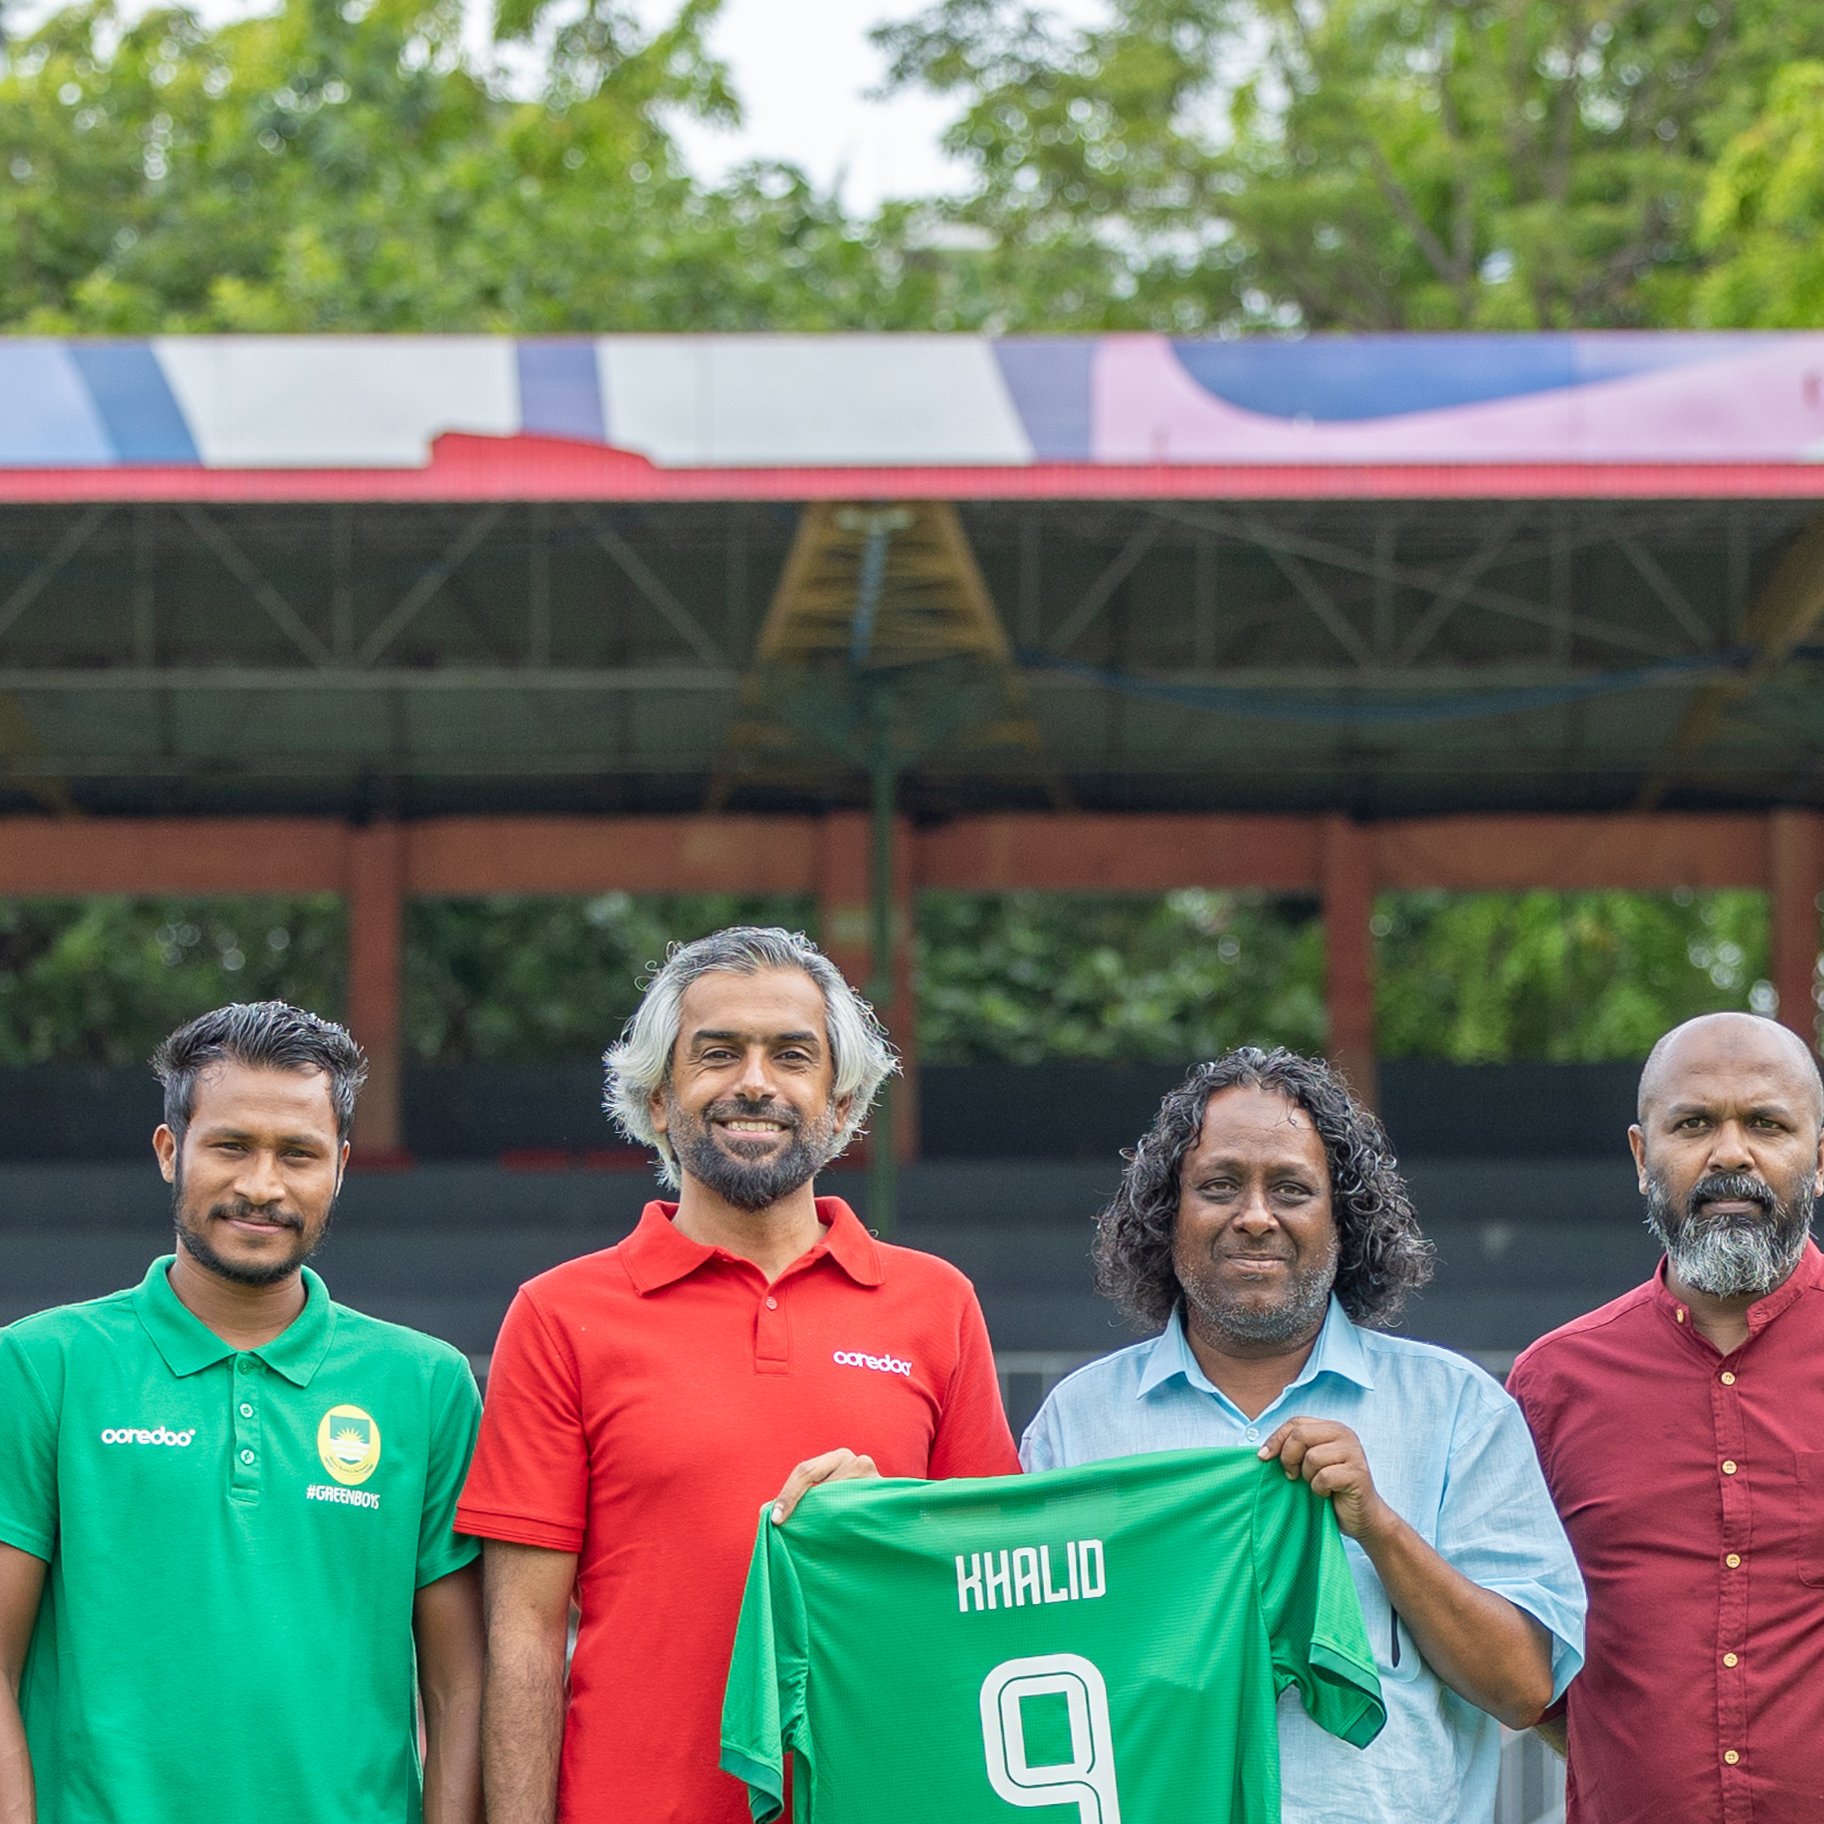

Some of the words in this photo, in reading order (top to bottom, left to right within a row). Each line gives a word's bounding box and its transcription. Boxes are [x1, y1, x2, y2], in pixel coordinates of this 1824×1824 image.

[833, 1351, 912, 1376] ooredoo
[101, 1426, 196, 1447] ooredoo
[306, 1484, 381, 1510] #GREENBOYS
[954, 1539, 1107, 1612] KHALID
